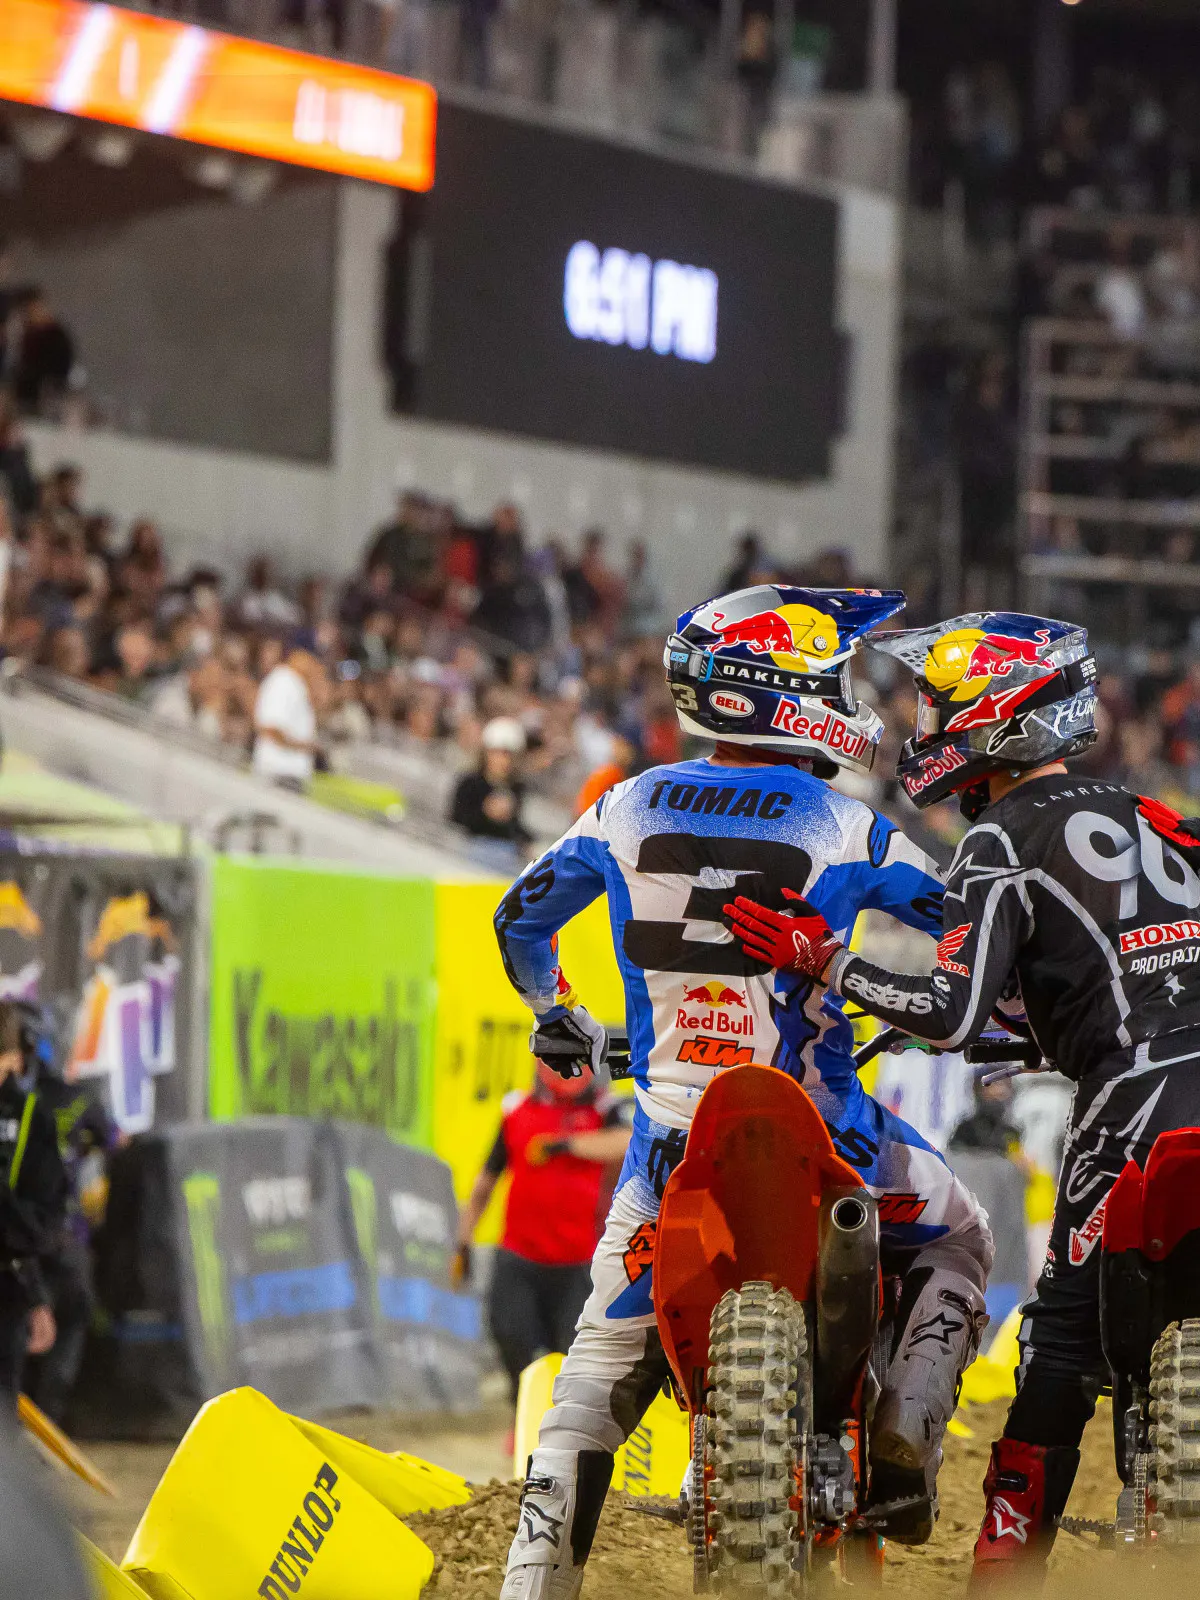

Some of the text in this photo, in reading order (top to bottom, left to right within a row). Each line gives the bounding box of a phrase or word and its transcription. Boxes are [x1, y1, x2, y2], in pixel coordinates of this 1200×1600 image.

[723, 665, 820, 690] OAKLEY
[671, 683, 699, 711] 3
[715, 695, 747, 713] BELL
[648, 780, 792, 820] TOMAC
[623, 833, 812, 977] 3
[676, 1009, 754, 1036] Red Bull
[676, 1035, 755, 1067] KTM
